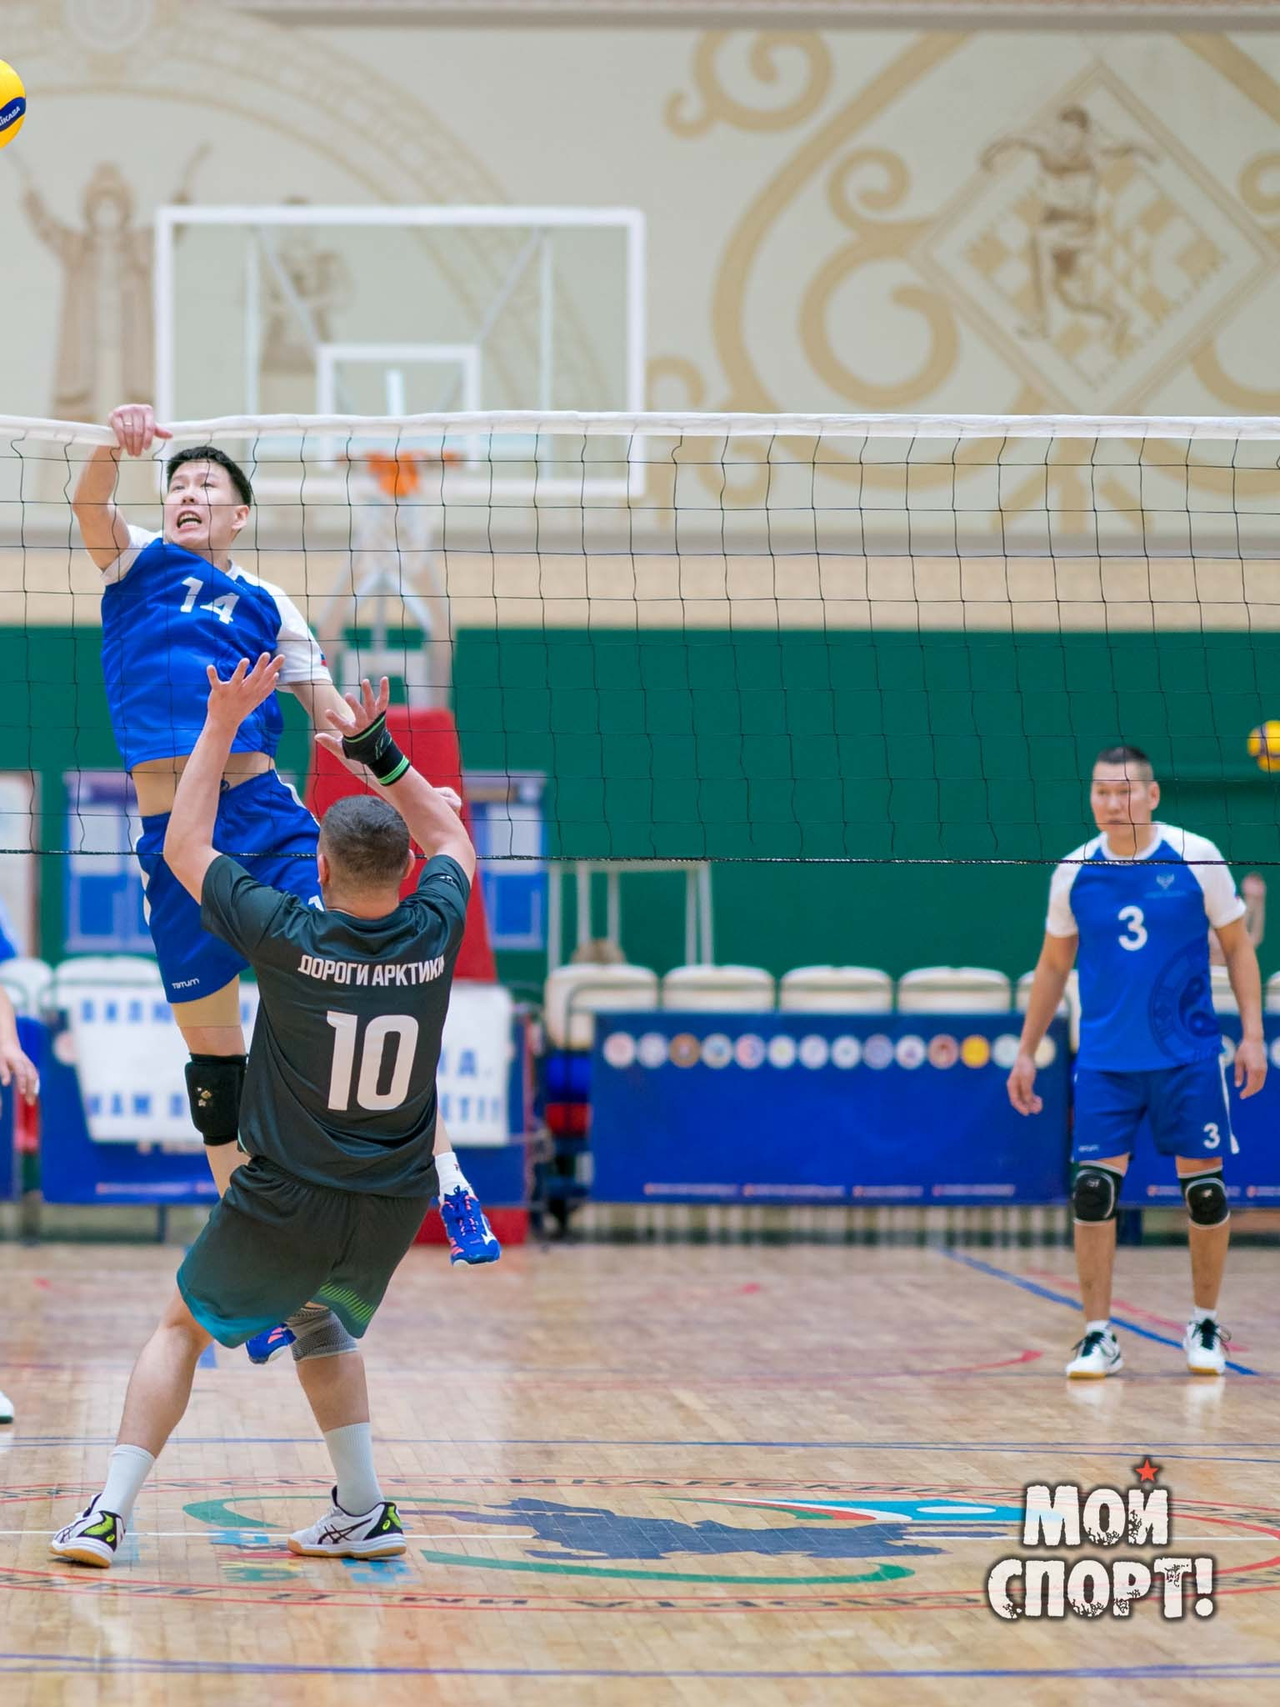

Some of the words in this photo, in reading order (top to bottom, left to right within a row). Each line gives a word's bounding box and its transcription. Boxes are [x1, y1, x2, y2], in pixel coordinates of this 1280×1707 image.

[180, 577, 240, 625] 14
[1118, 905, 1148, 951] 3
[297, 954, 369, 985] ДОРОГИ
[372, 954, 446, 987] АРКТИКИ
[326, 1010, 419, 1111] 10
[1203, 1122, 1221, 1149] 3
